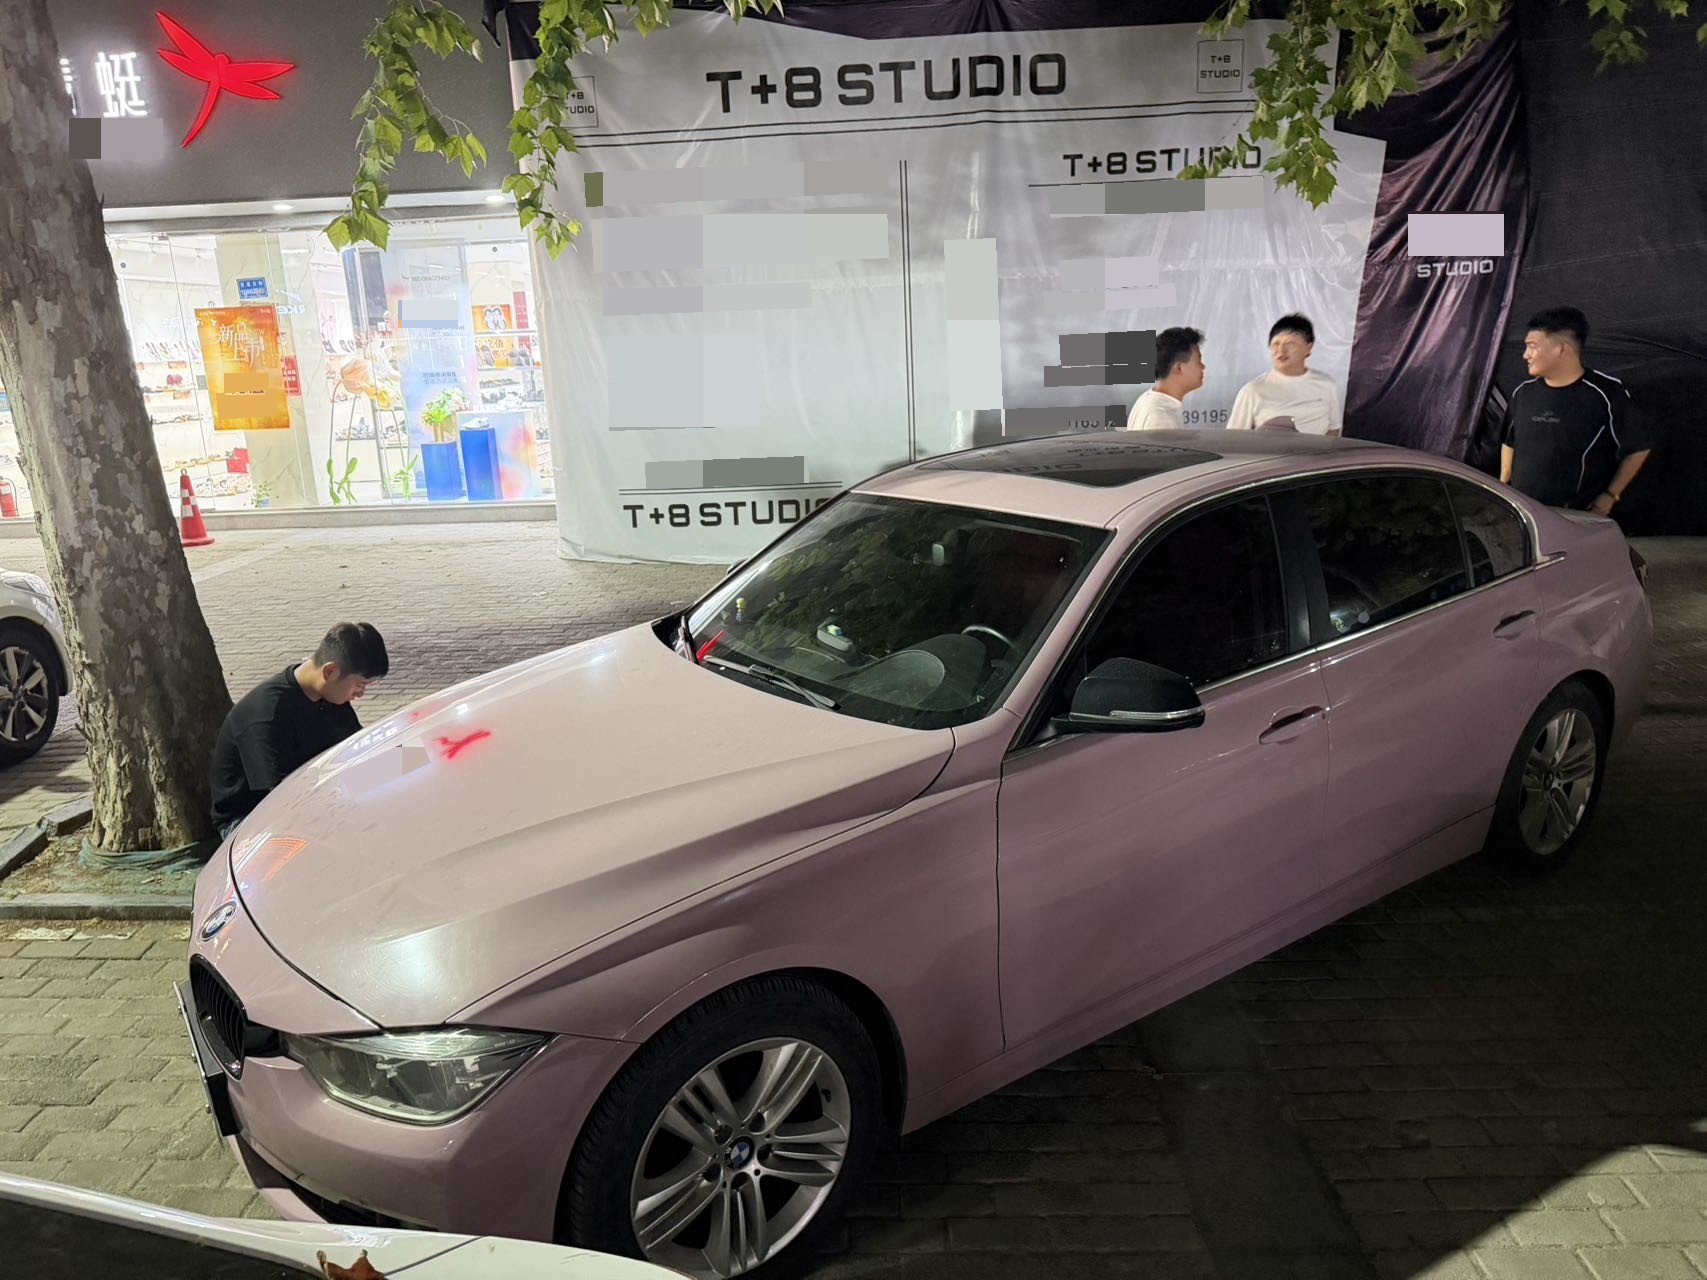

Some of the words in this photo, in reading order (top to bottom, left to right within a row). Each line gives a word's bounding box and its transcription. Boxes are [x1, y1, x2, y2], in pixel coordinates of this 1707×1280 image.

[1210, 54, 1231, 64] T+8
[705, 66, 823, 113] T+8
[837, 53, 1066, 106] STUDIO
[1200, 69, 1240, 78] STUDIO
[565, 105, 595, 114] UDIO
[1063, 152, 1127, 177] T+8
[1417, 259, 1494, 278] STUDIO
[623, 504, 690, 528] T+8
[700, 498, 830, 526] STUDI
